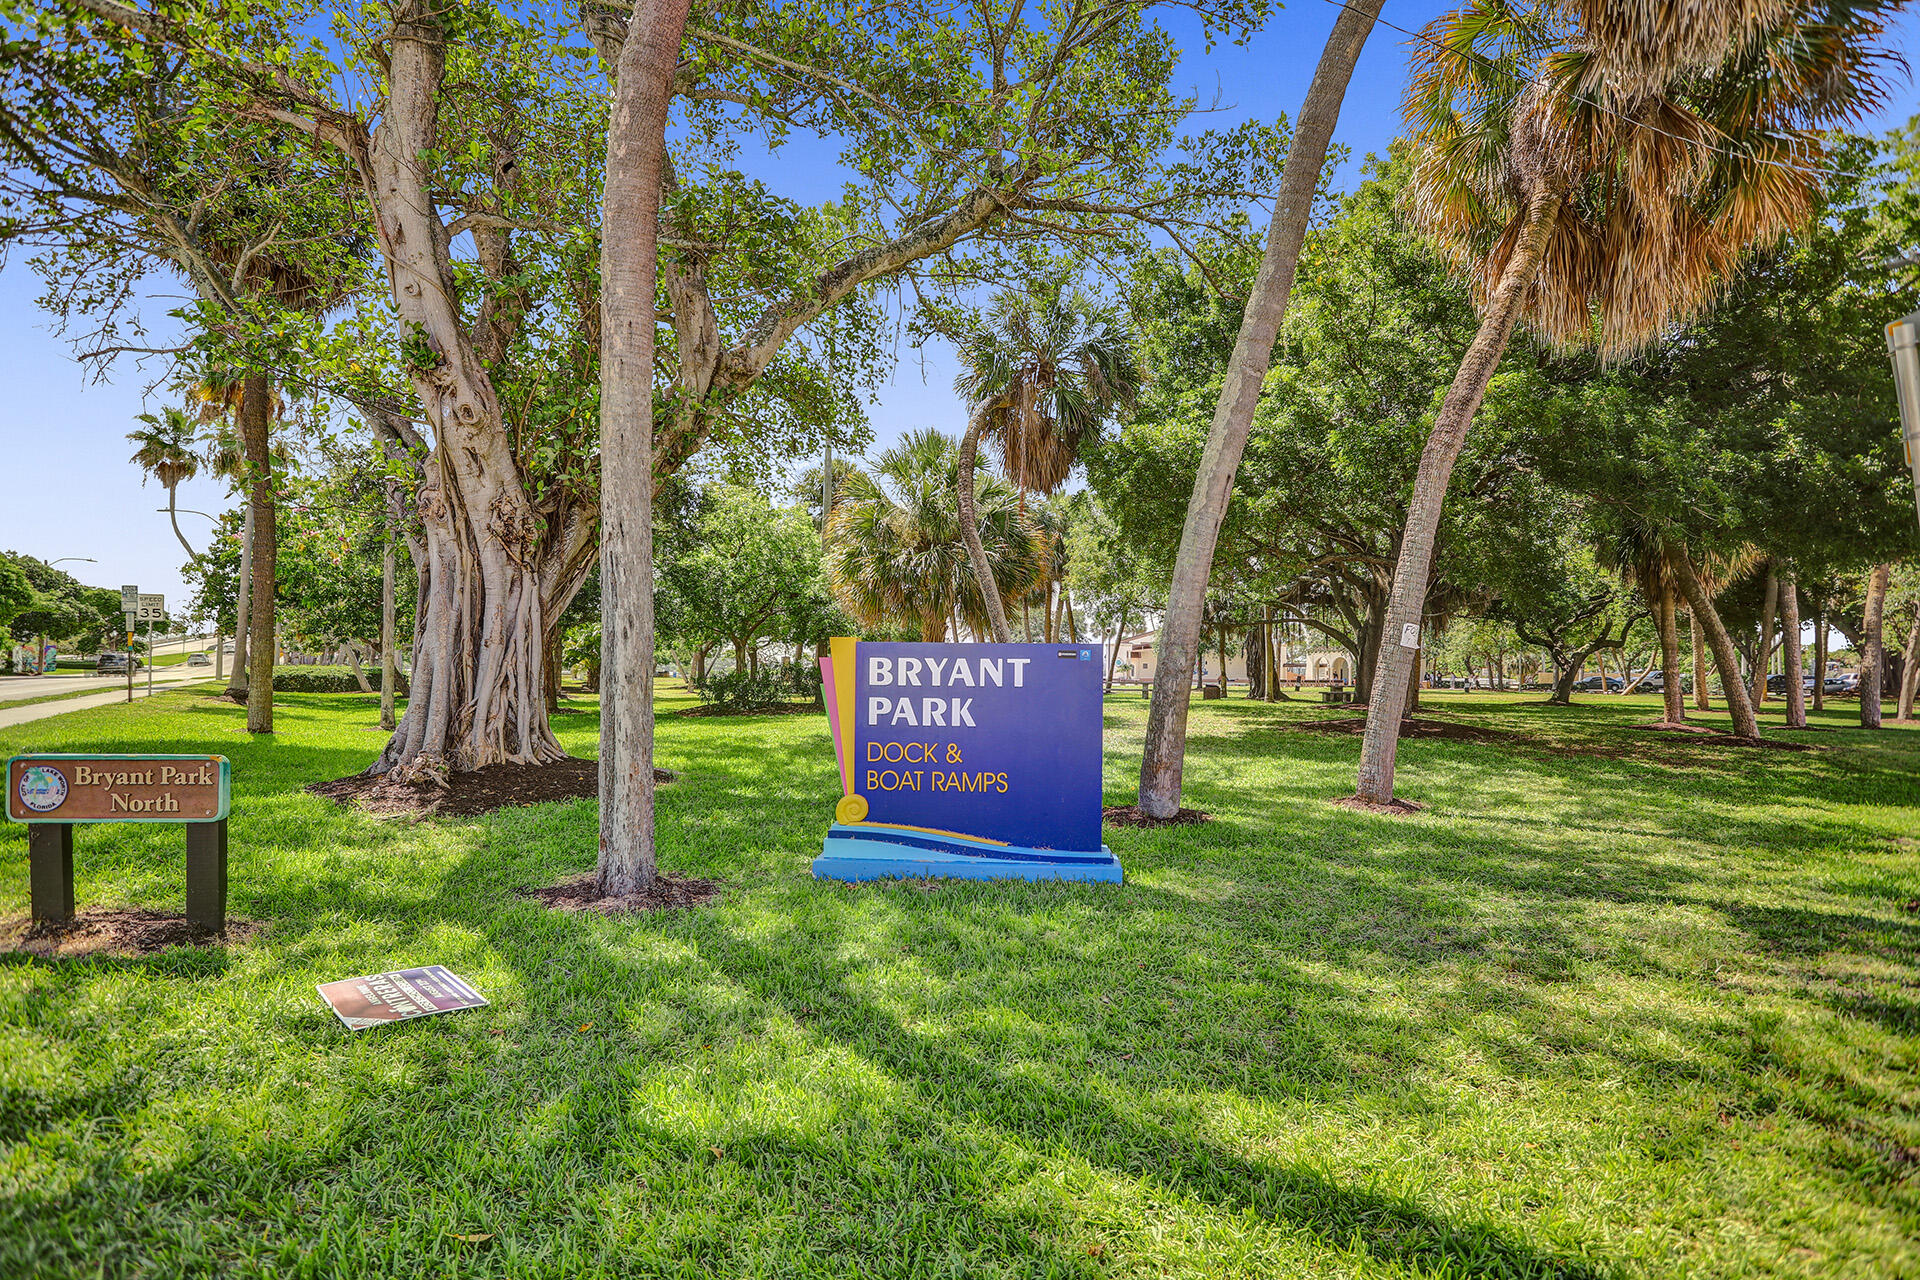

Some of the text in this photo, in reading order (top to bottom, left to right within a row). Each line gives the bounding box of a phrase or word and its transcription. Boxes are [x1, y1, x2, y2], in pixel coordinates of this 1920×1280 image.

[140, 608, 161, 618] 35
[868, 657, 1031, 688] BRYANT
[868, 697, 976, 727] PARK
[867, 742, 963, 764] DOCK &
[41, 768, 66, 796] LAKE WORTH
[74, 766, 213, 791] Bryant Park
[867, 770, 1008, 793] BOAT RAMPS
[30, 801, 57, 809] FLORIDA
[110, 792, 179, 812] North
